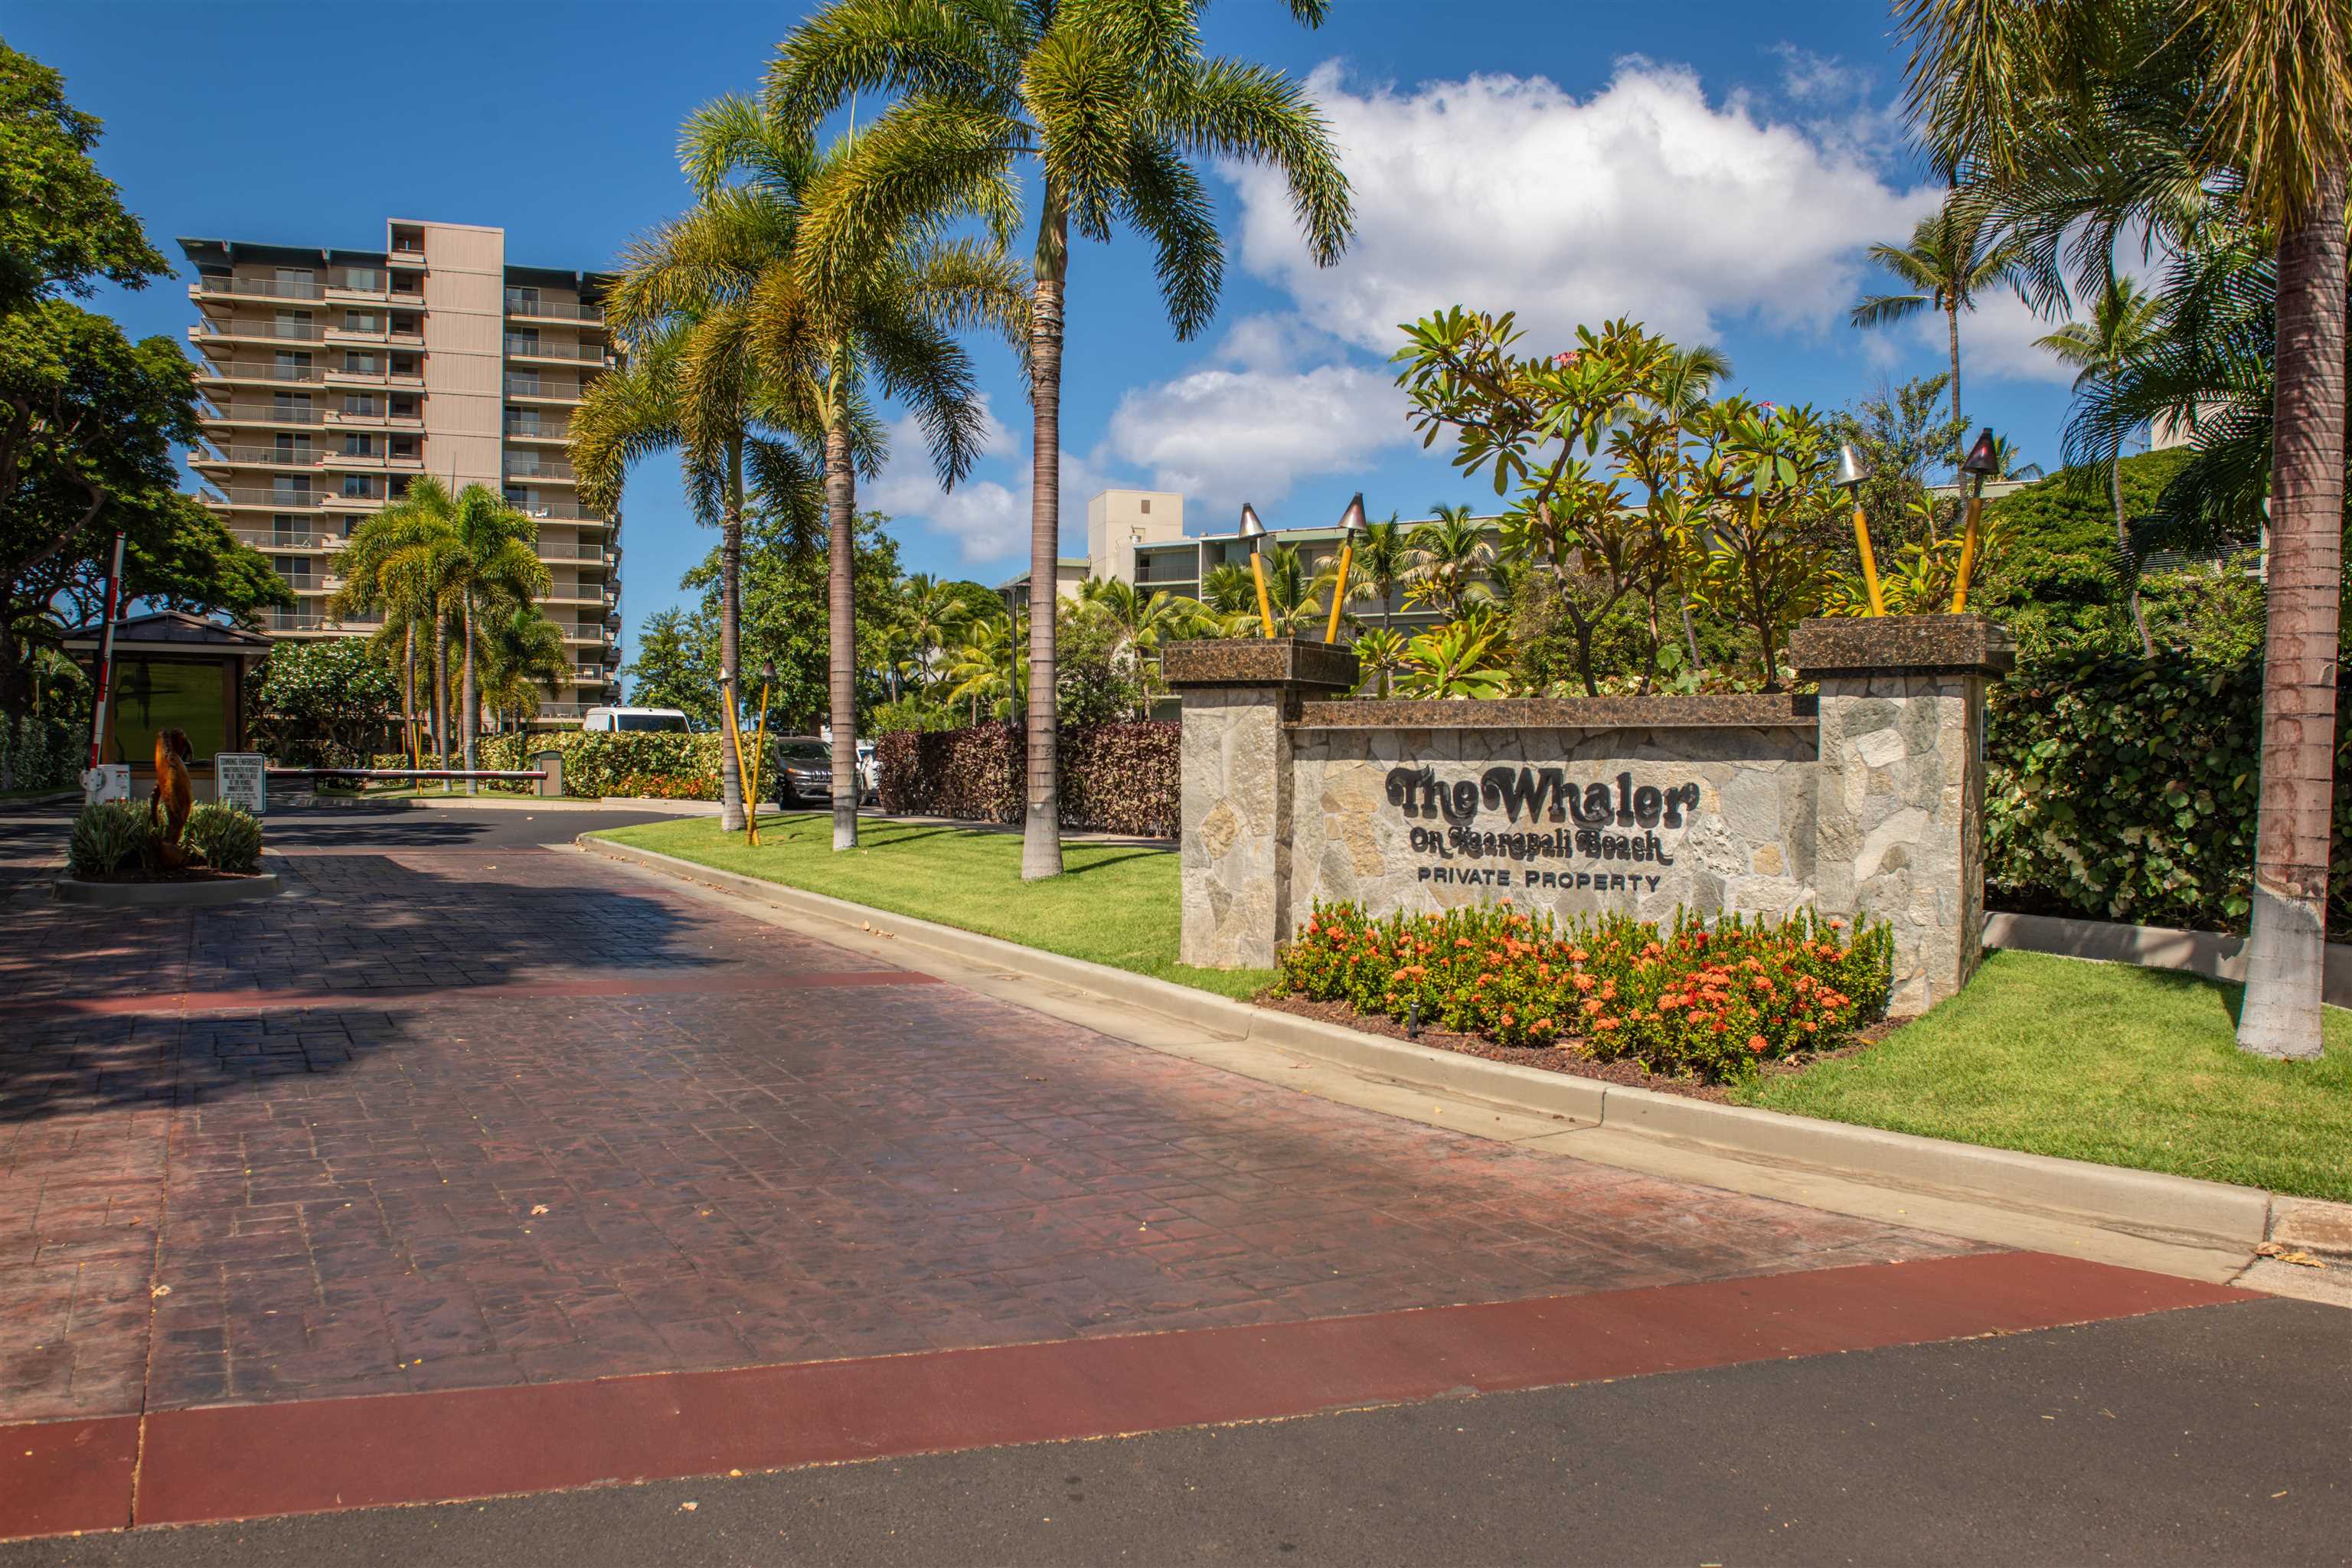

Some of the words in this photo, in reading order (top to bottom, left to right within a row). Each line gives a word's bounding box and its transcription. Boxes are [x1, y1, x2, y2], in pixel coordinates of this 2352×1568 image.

[1385, 764, 1478, 826] The
[1481, 767, 1700, 830] Whaler
[1410, 827, 1454, 859] On
[1448, 826, 1573, 861] Kaanapali
[1575, 829, 1674, 866] Beach
[1417, 867, 1511, 887] PRIVATE
[1525, 870, 1661, 893] PROPERTY
